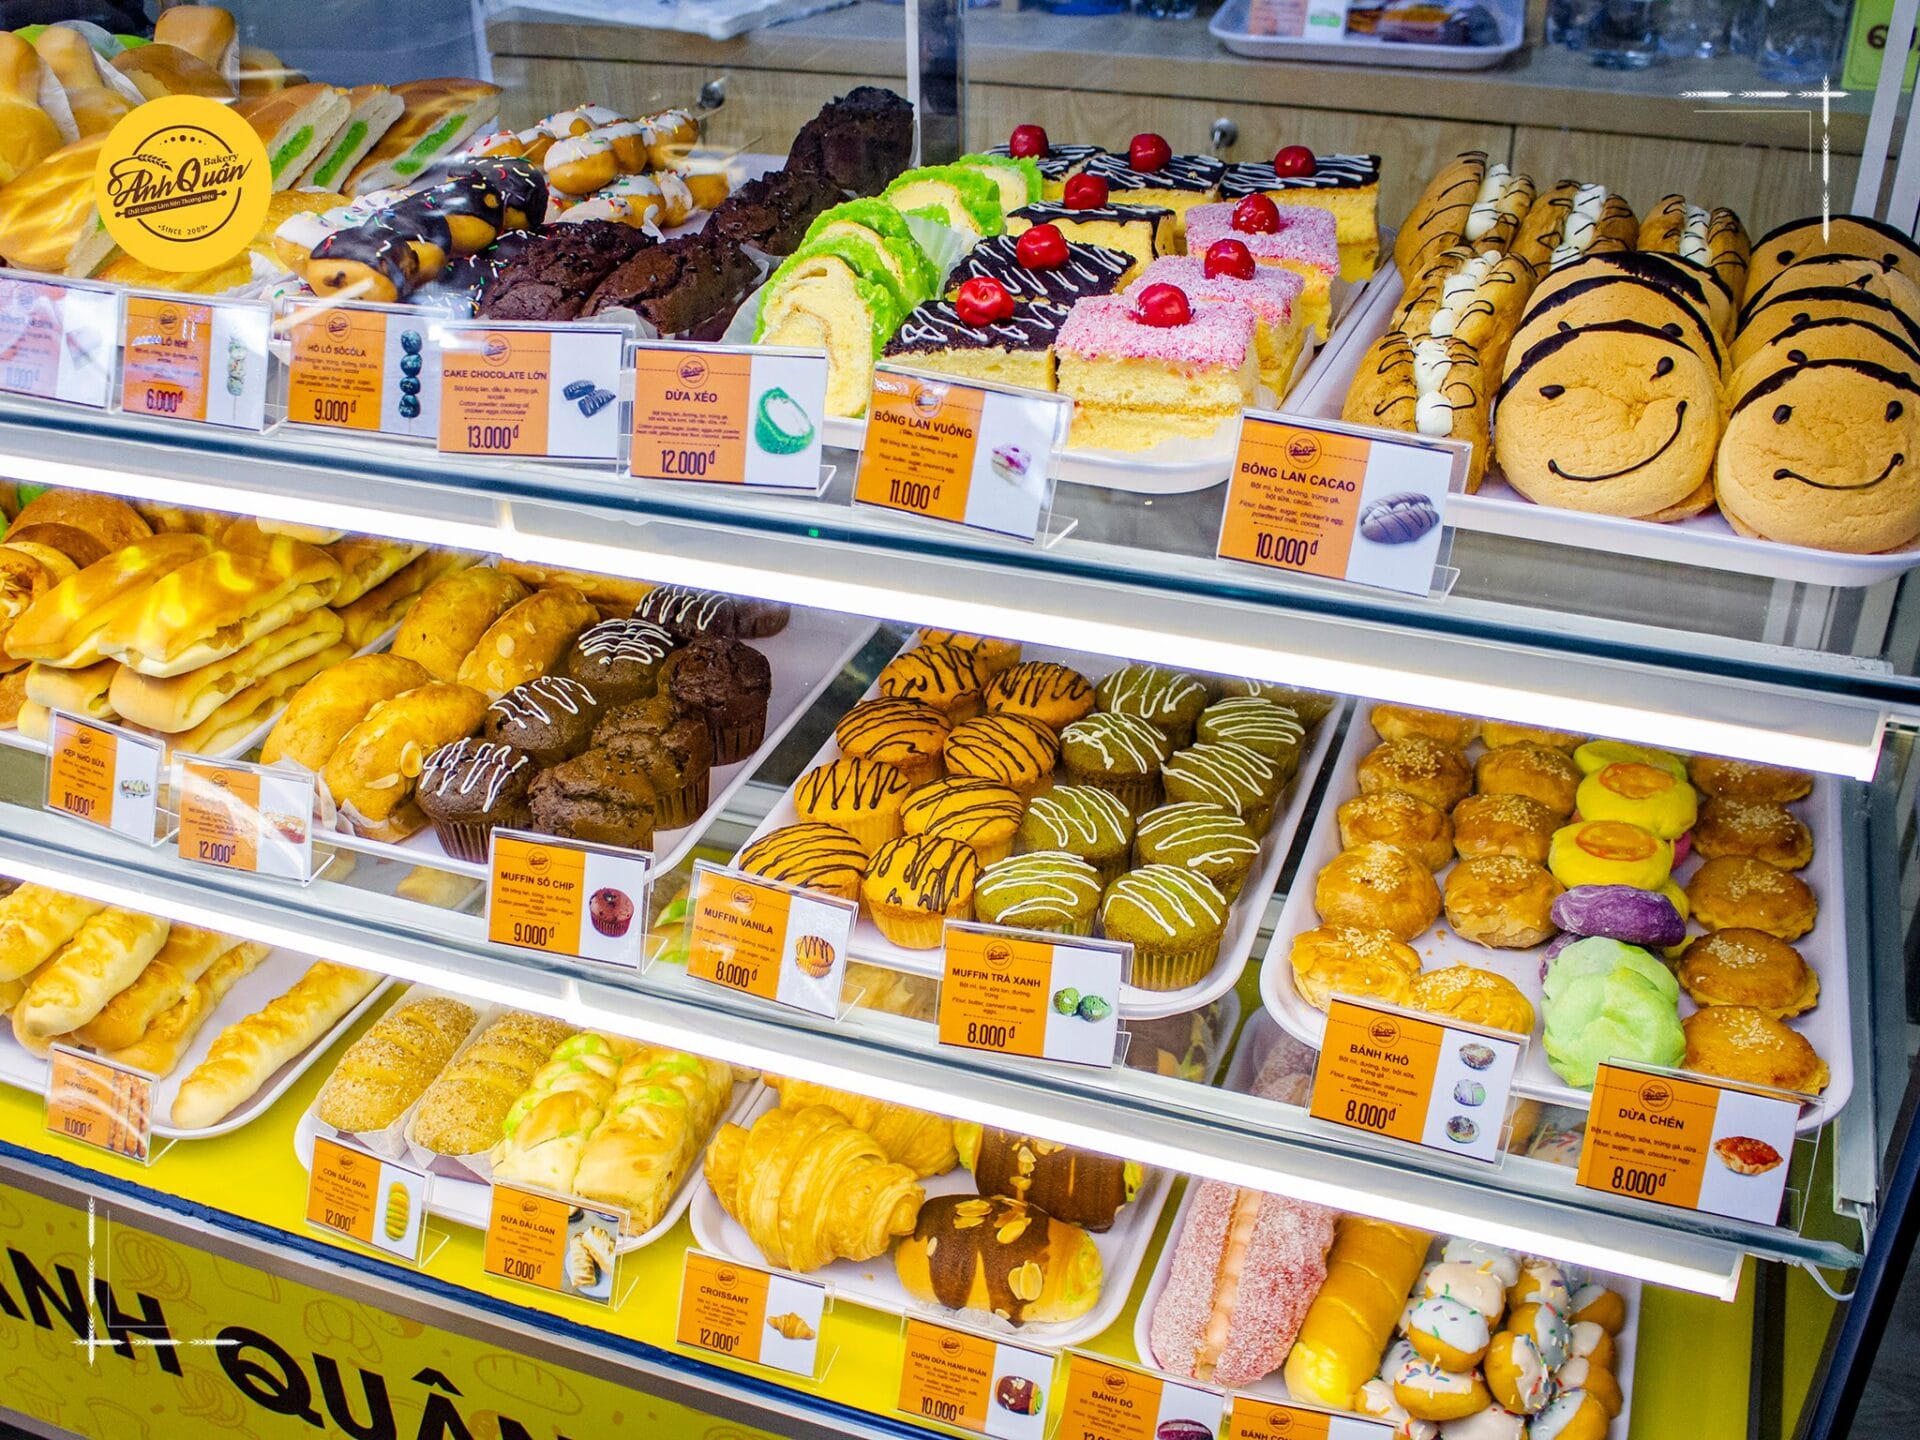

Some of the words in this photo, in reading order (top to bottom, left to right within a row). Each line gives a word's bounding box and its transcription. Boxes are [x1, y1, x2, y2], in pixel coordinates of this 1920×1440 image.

[443, 369, 468, 377] CAKE
[470, 370, 524, 378] CHOCOLATE
[693, 390, 718, 402] XÉO
[314, 398, 356, 423] 9.000đ
[467, 425, 519, 449] 13.000đ
[908, 417, 930, 430] LAN
[933, 422, 972, 439] VUÔNG
[661, 449, 715, 475] 12.000đ
[1280, 469, 1306, 483] LAN
[1309, 475, 1356, 492] CACAO
[1256, 532, 1318, 566] 10.000đ
[500, 871, 534, 884] MUFFIN
[552, 880, 574, 891] CHIP
[704, 907, 737, 924] MUFFIN
[740, 918, 773, 935] VANILA
[513, 922, 554, 946] 9.000đ
[715, 960, 758, 988] 8.000đ
[952, 967, 988, 980] MUFFIN
[1013, 976, 1041, 987] XANH
[967, 1022, 1015, 1048] 8.000đ
[1350, 1043, 1382, 1059] BÁNH
[1345, 1099, 1396, 1129] 8.000đ
[1618, 1108, 1646, 1122] DỪA
[1649, 1114, 1684, 1130] CHÉN
[1612, 1166, 1666, 1196] 8.000đ
[533, 1224, 555, 1236] LOAN
[700, 1285, 749, 1304] CROISSANT
[700, 1328, 739, 1352] 12.000đ
[921, 1396, 964, 1422] 10.000đ
